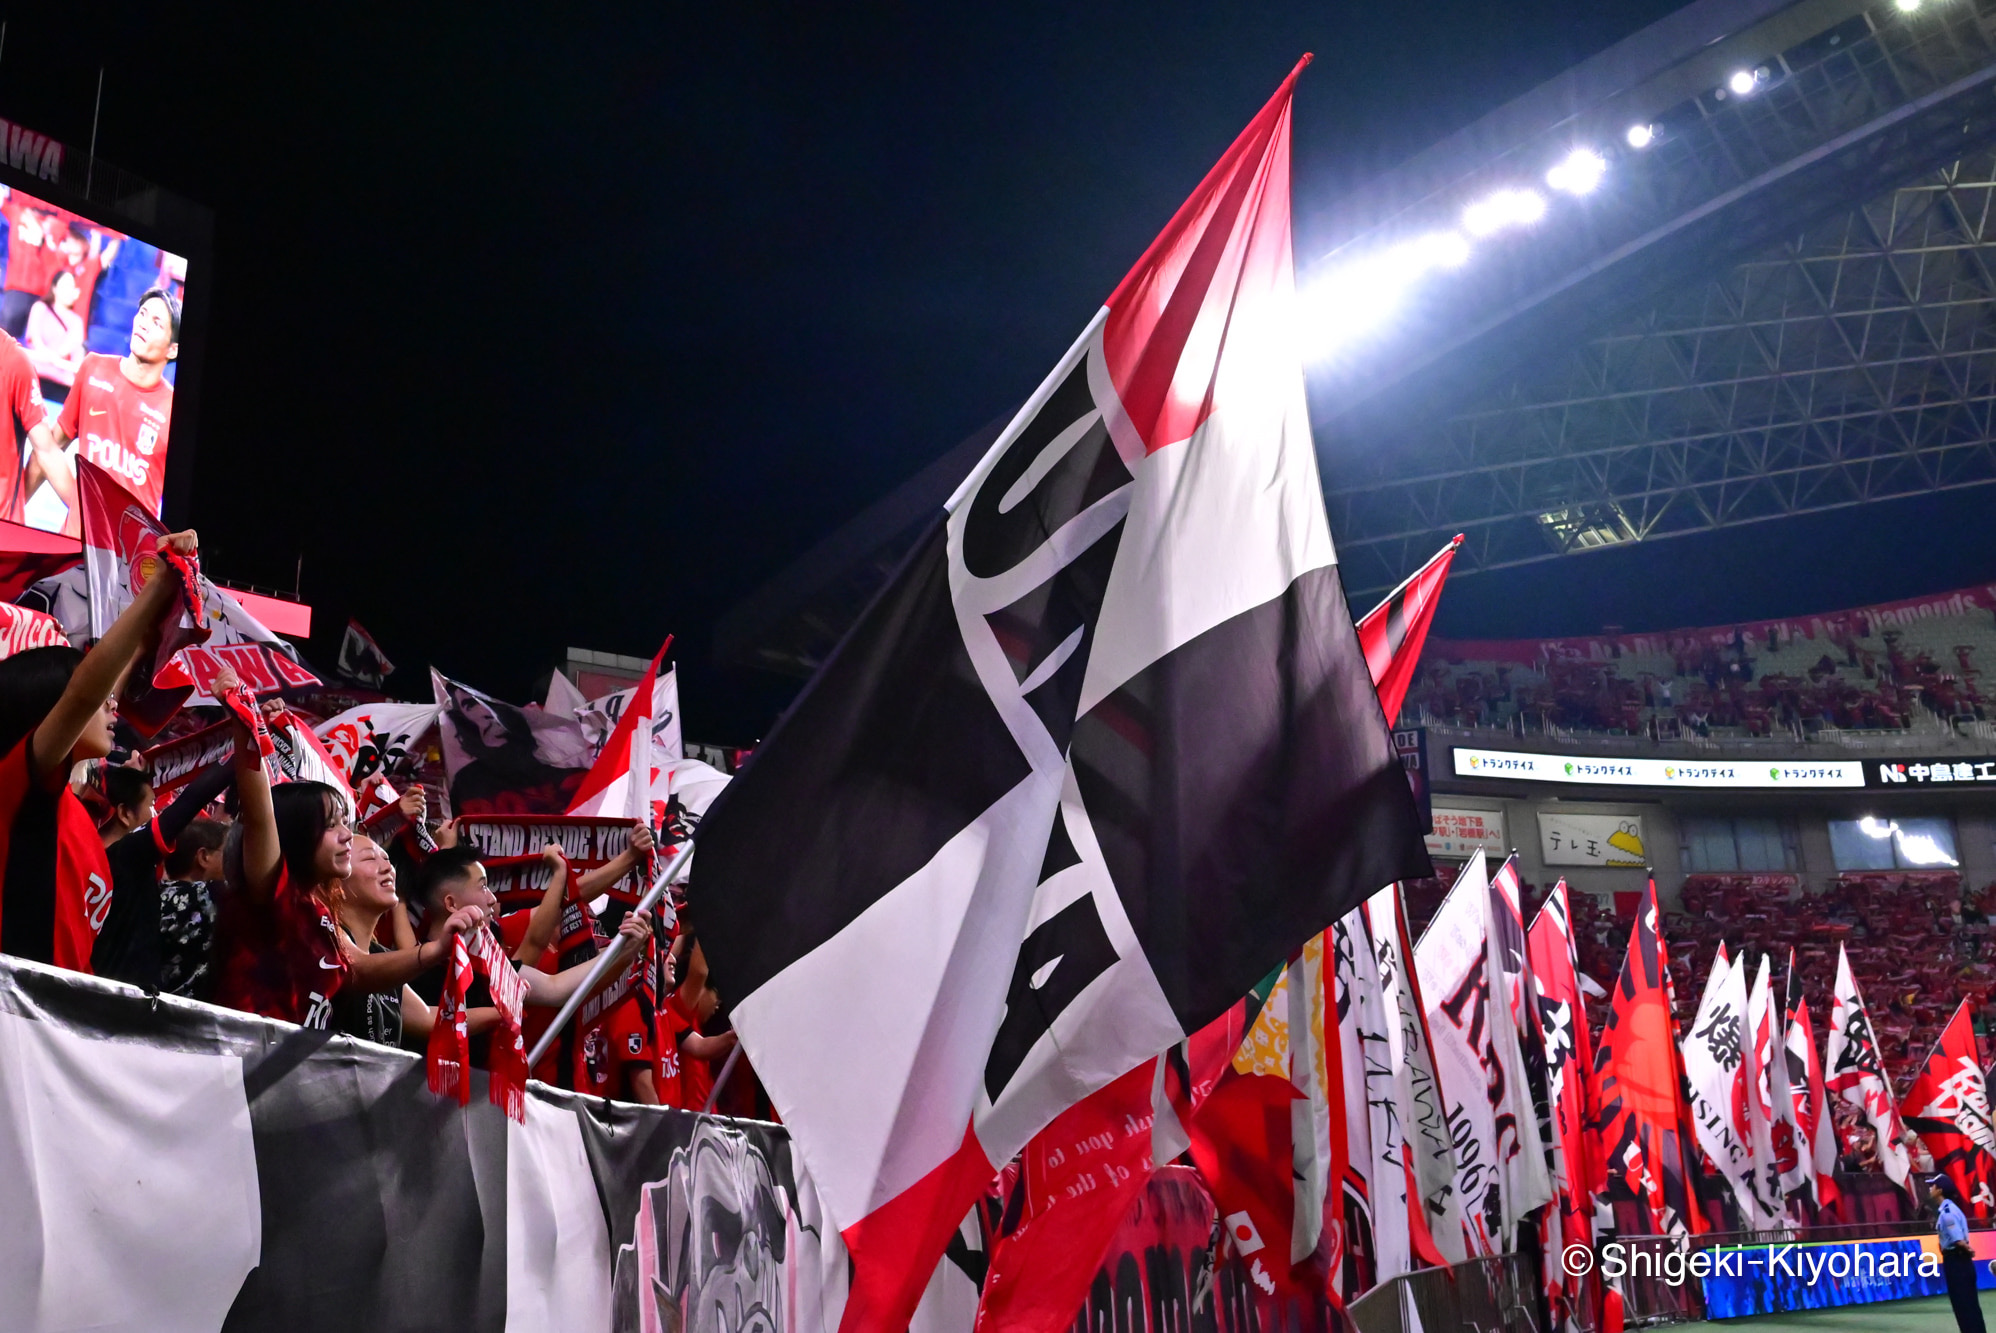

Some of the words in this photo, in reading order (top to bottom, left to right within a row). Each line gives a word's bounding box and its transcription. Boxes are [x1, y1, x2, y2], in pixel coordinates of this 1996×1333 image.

[88, 434, 150, 486] POLUS
[469, 823, 525, 857] STAND
[528, 824, 592, 860] BESIDE
[1550, 831, 1601, 857] テレ玉
